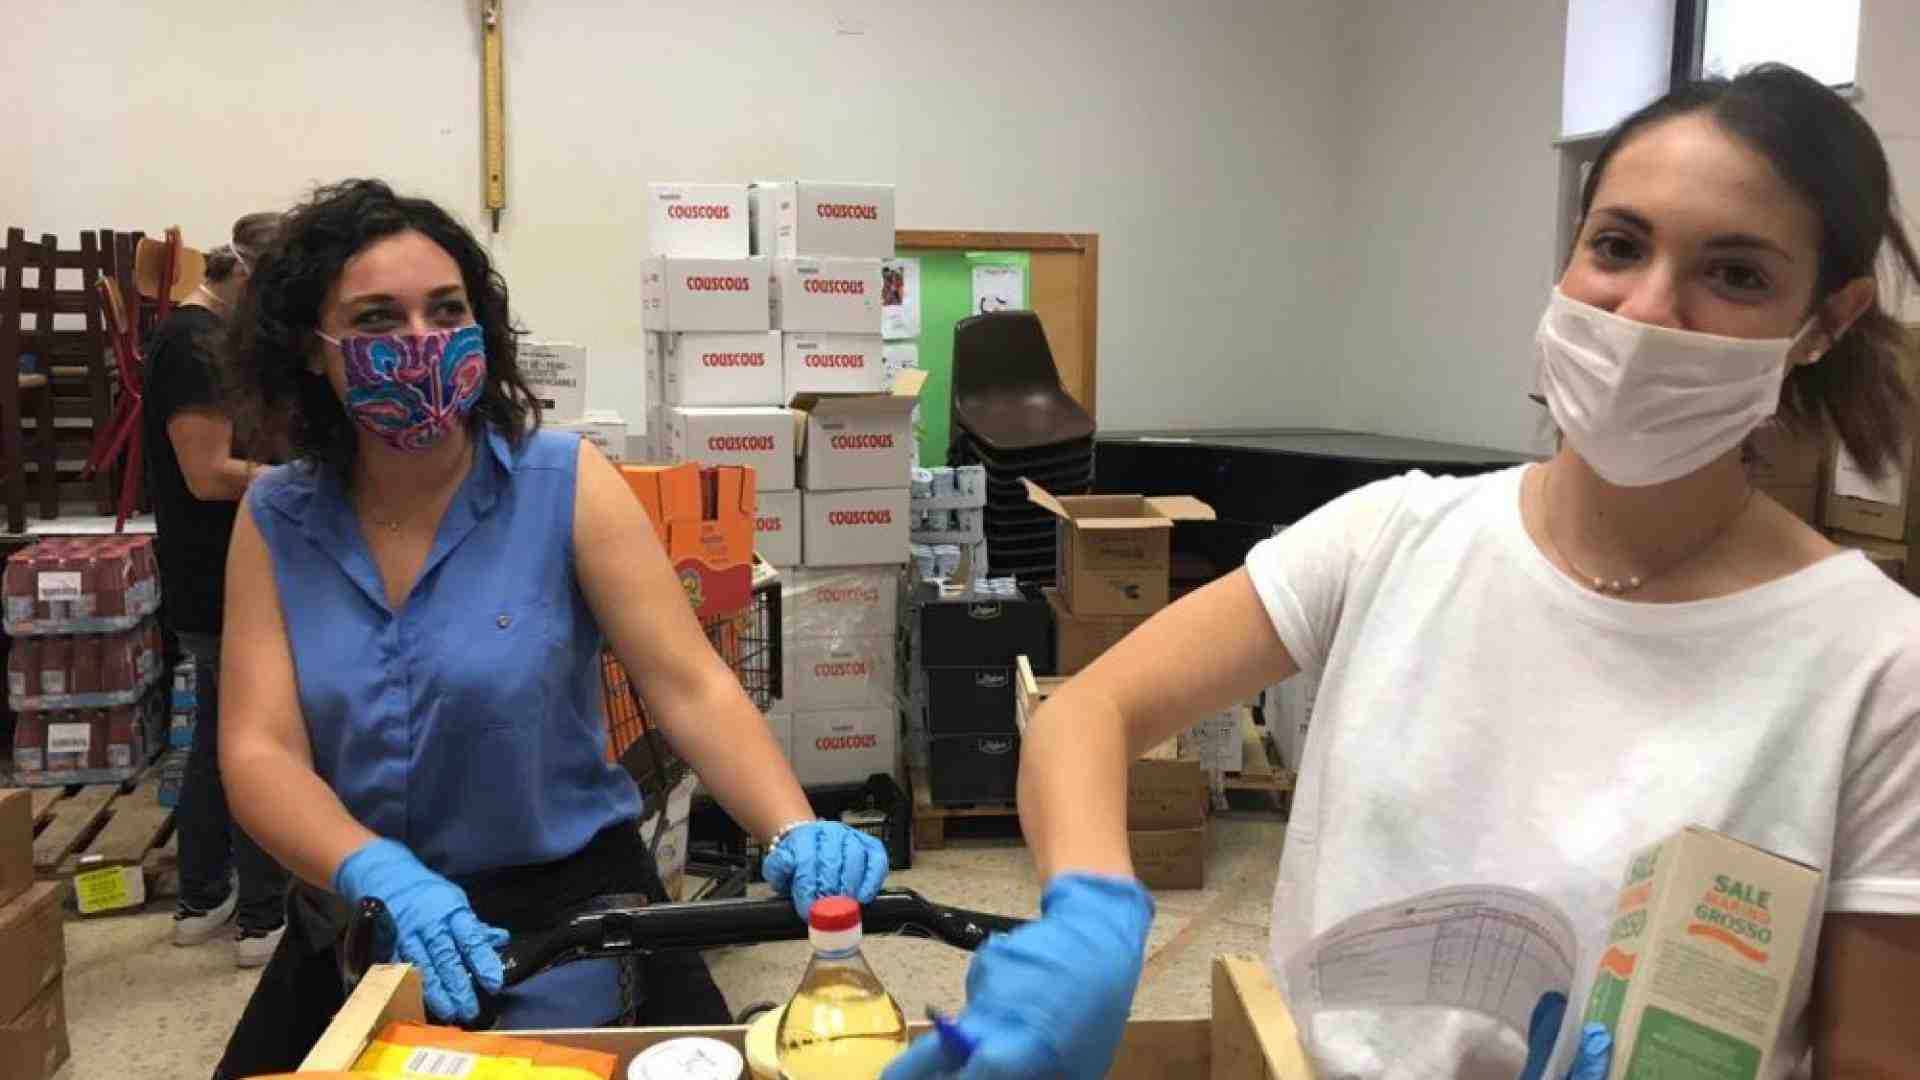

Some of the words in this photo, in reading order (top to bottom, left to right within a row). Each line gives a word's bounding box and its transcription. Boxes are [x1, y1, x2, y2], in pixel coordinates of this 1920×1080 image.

[668, 205, 730, 220] COUSCOUS
[817, 204, 877, 220] COUSCOUS
[687, 275, 749, 292] COUSCOUS
[804, 279, 864, 295] COUSCOUS
[702, 352, 765, 367] COUSCOUS
[805, 353, 864, 369] COUSCOUS
[708, 434, 774, 452] COUSCOUS
[831, 432, 893, 450] COUSCOUS
[829, 510, 892, 526] COUSCOUS
[815, 734, 876, 751] COUSCOUS
[1714, 874, 1773, 909] SALE
[1695, 904, 1773, 944] GROSSO
